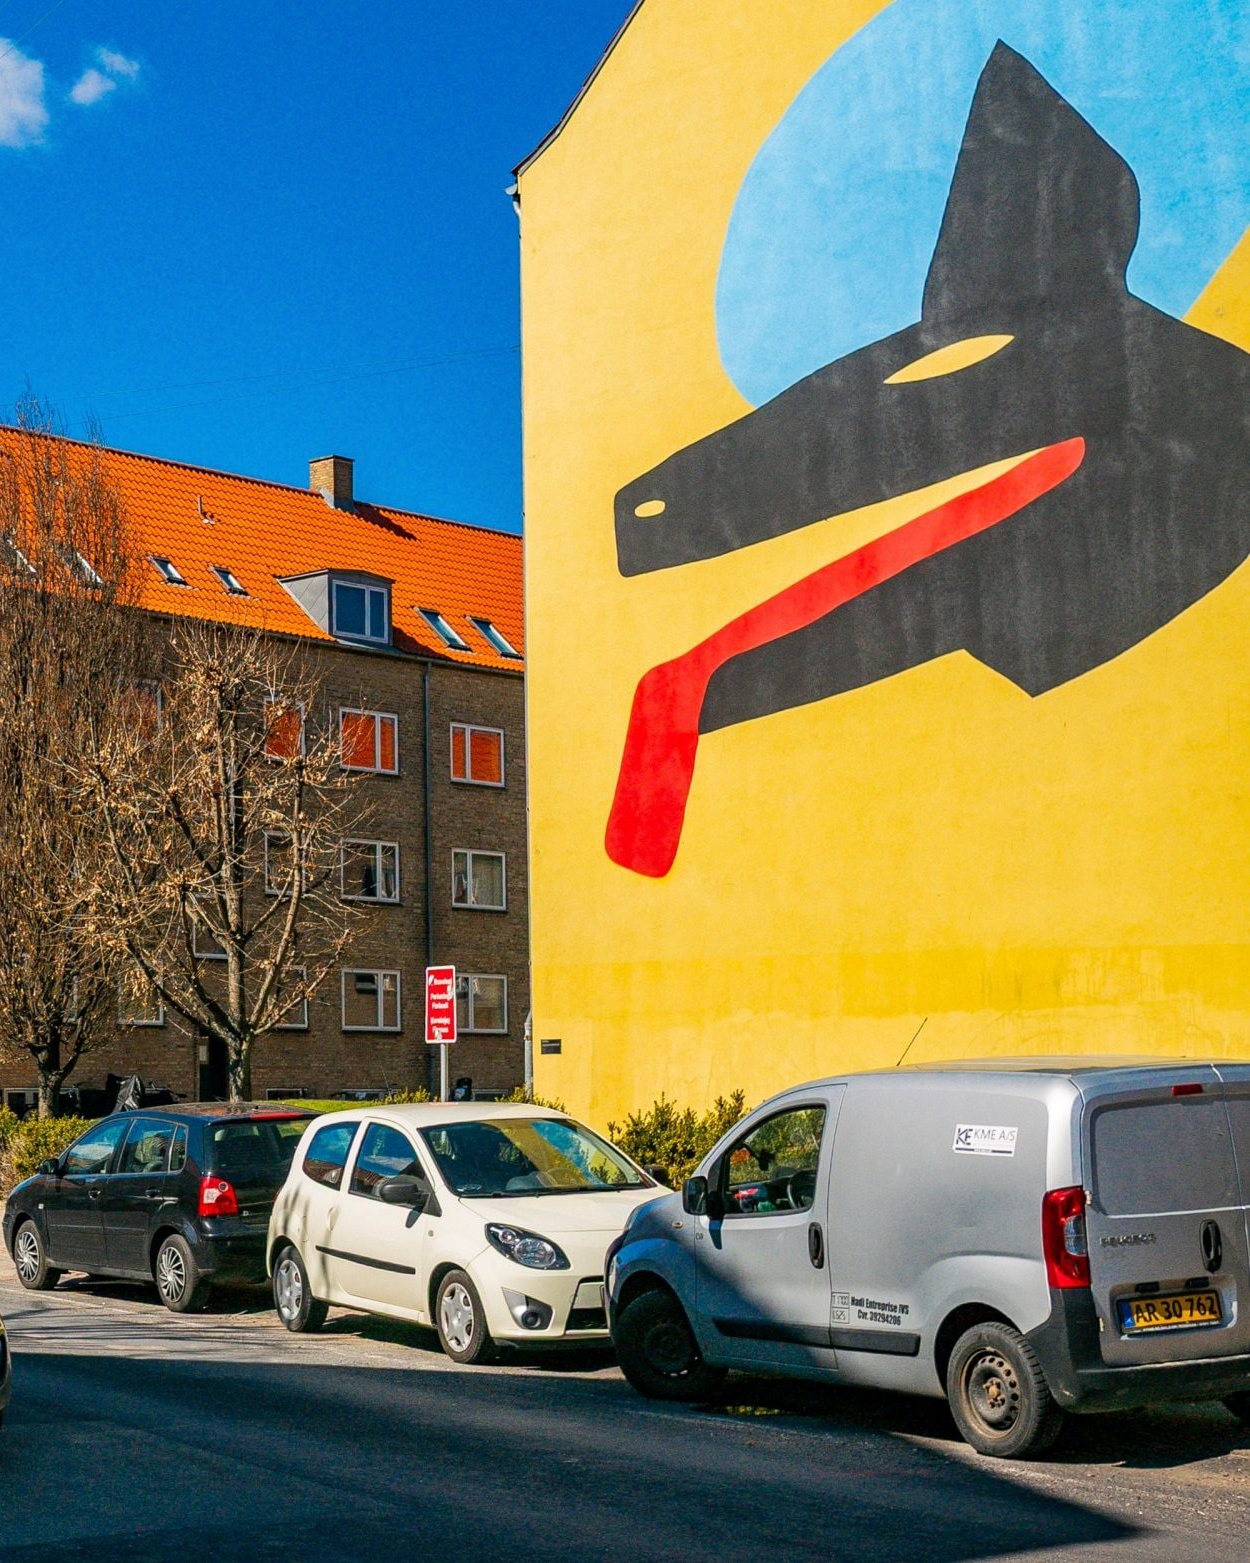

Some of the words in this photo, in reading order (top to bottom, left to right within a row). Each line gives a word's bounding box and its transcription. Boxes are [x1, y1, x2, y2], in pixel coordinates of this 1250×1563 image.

[974, 1128, 997, 1141] KME
[998, 1129, 1016, 1142] A/S
[866, 1299, 898, 1312] Entreprise
[1135, 1303, 1159, 1323] AR
[1161, 1300, 1182, 1320] 30
[1185, 1296, 1217, 1317] 762
